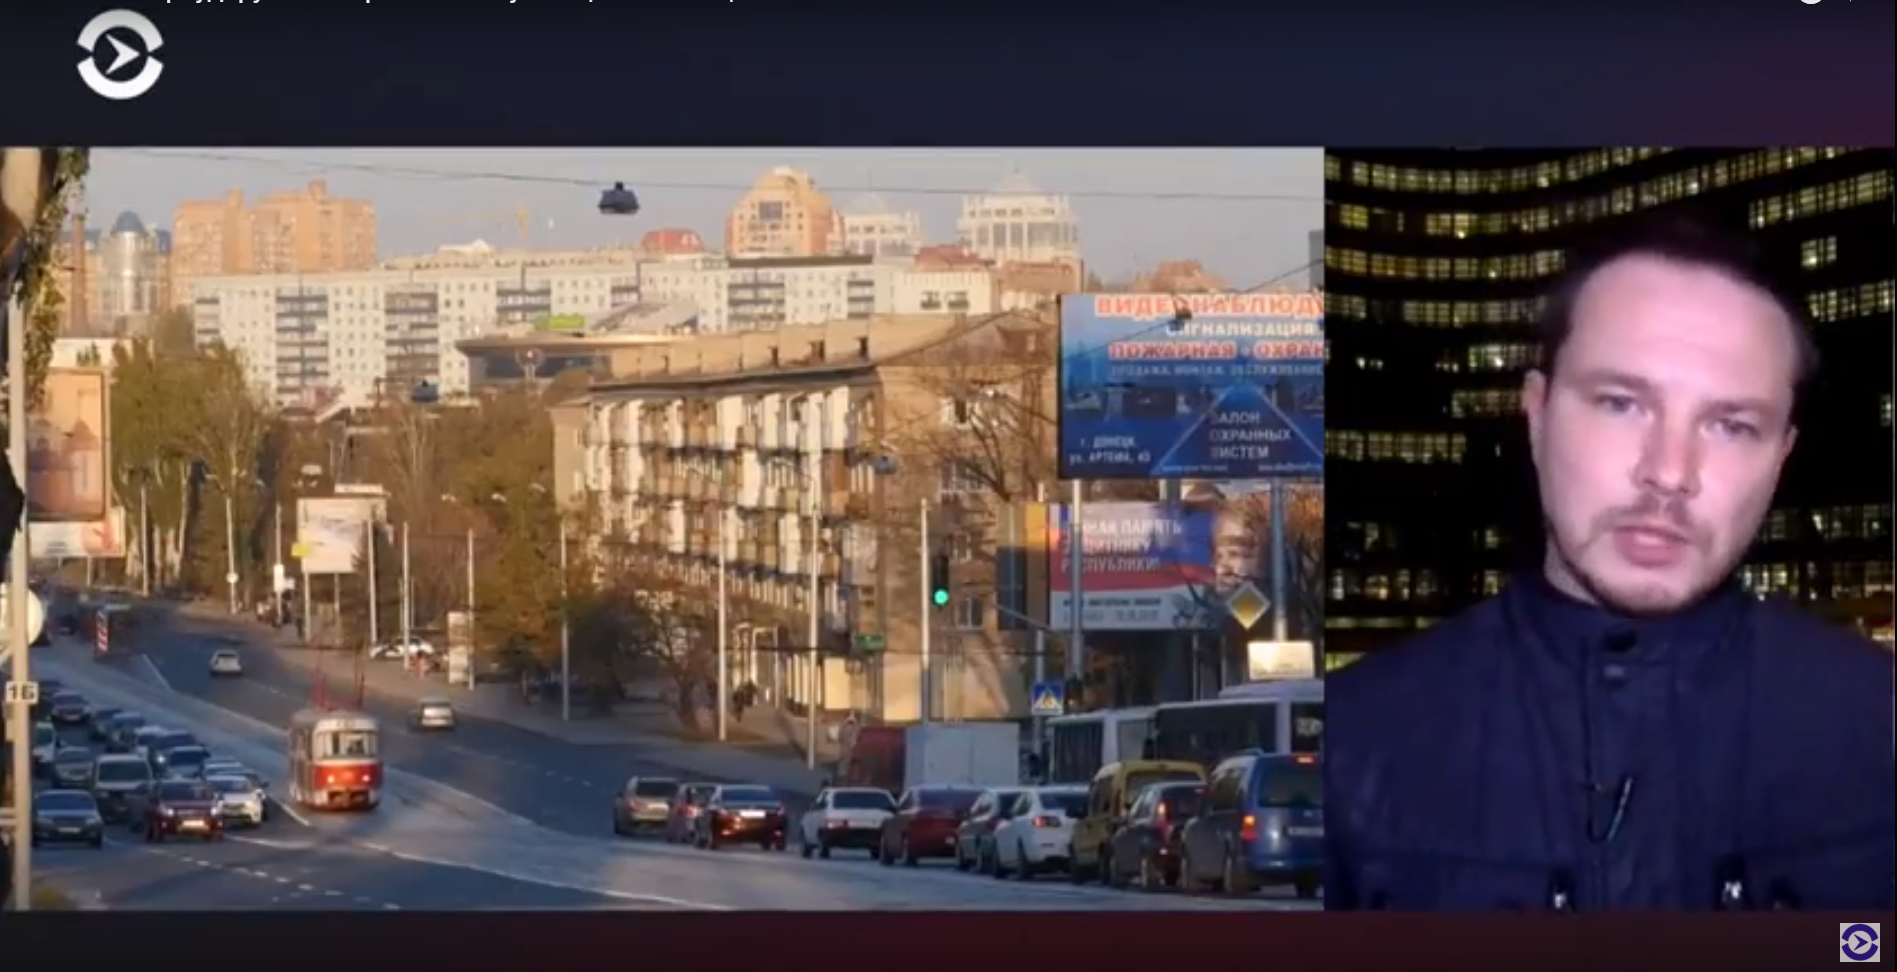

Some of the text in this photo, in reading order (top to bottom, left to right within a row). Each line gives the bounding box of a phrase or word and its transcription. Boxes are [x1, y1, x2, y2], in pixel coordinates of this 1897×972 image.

[1095, 295, 1324, 319] ВИДЕОНАБЛЮД
[1108, 342, 1236, 358] ПОЖАРНАЯ
[1209, 428, 1291, 441] ОХРАННЫХ
[1120, 519, 1181, 535] ПАМЯТЬ
[1063, 537, 1151, 555] ЗЩИТНИКУ
[1062, 556, 1159, 573] РСПУБЛИКИ!
